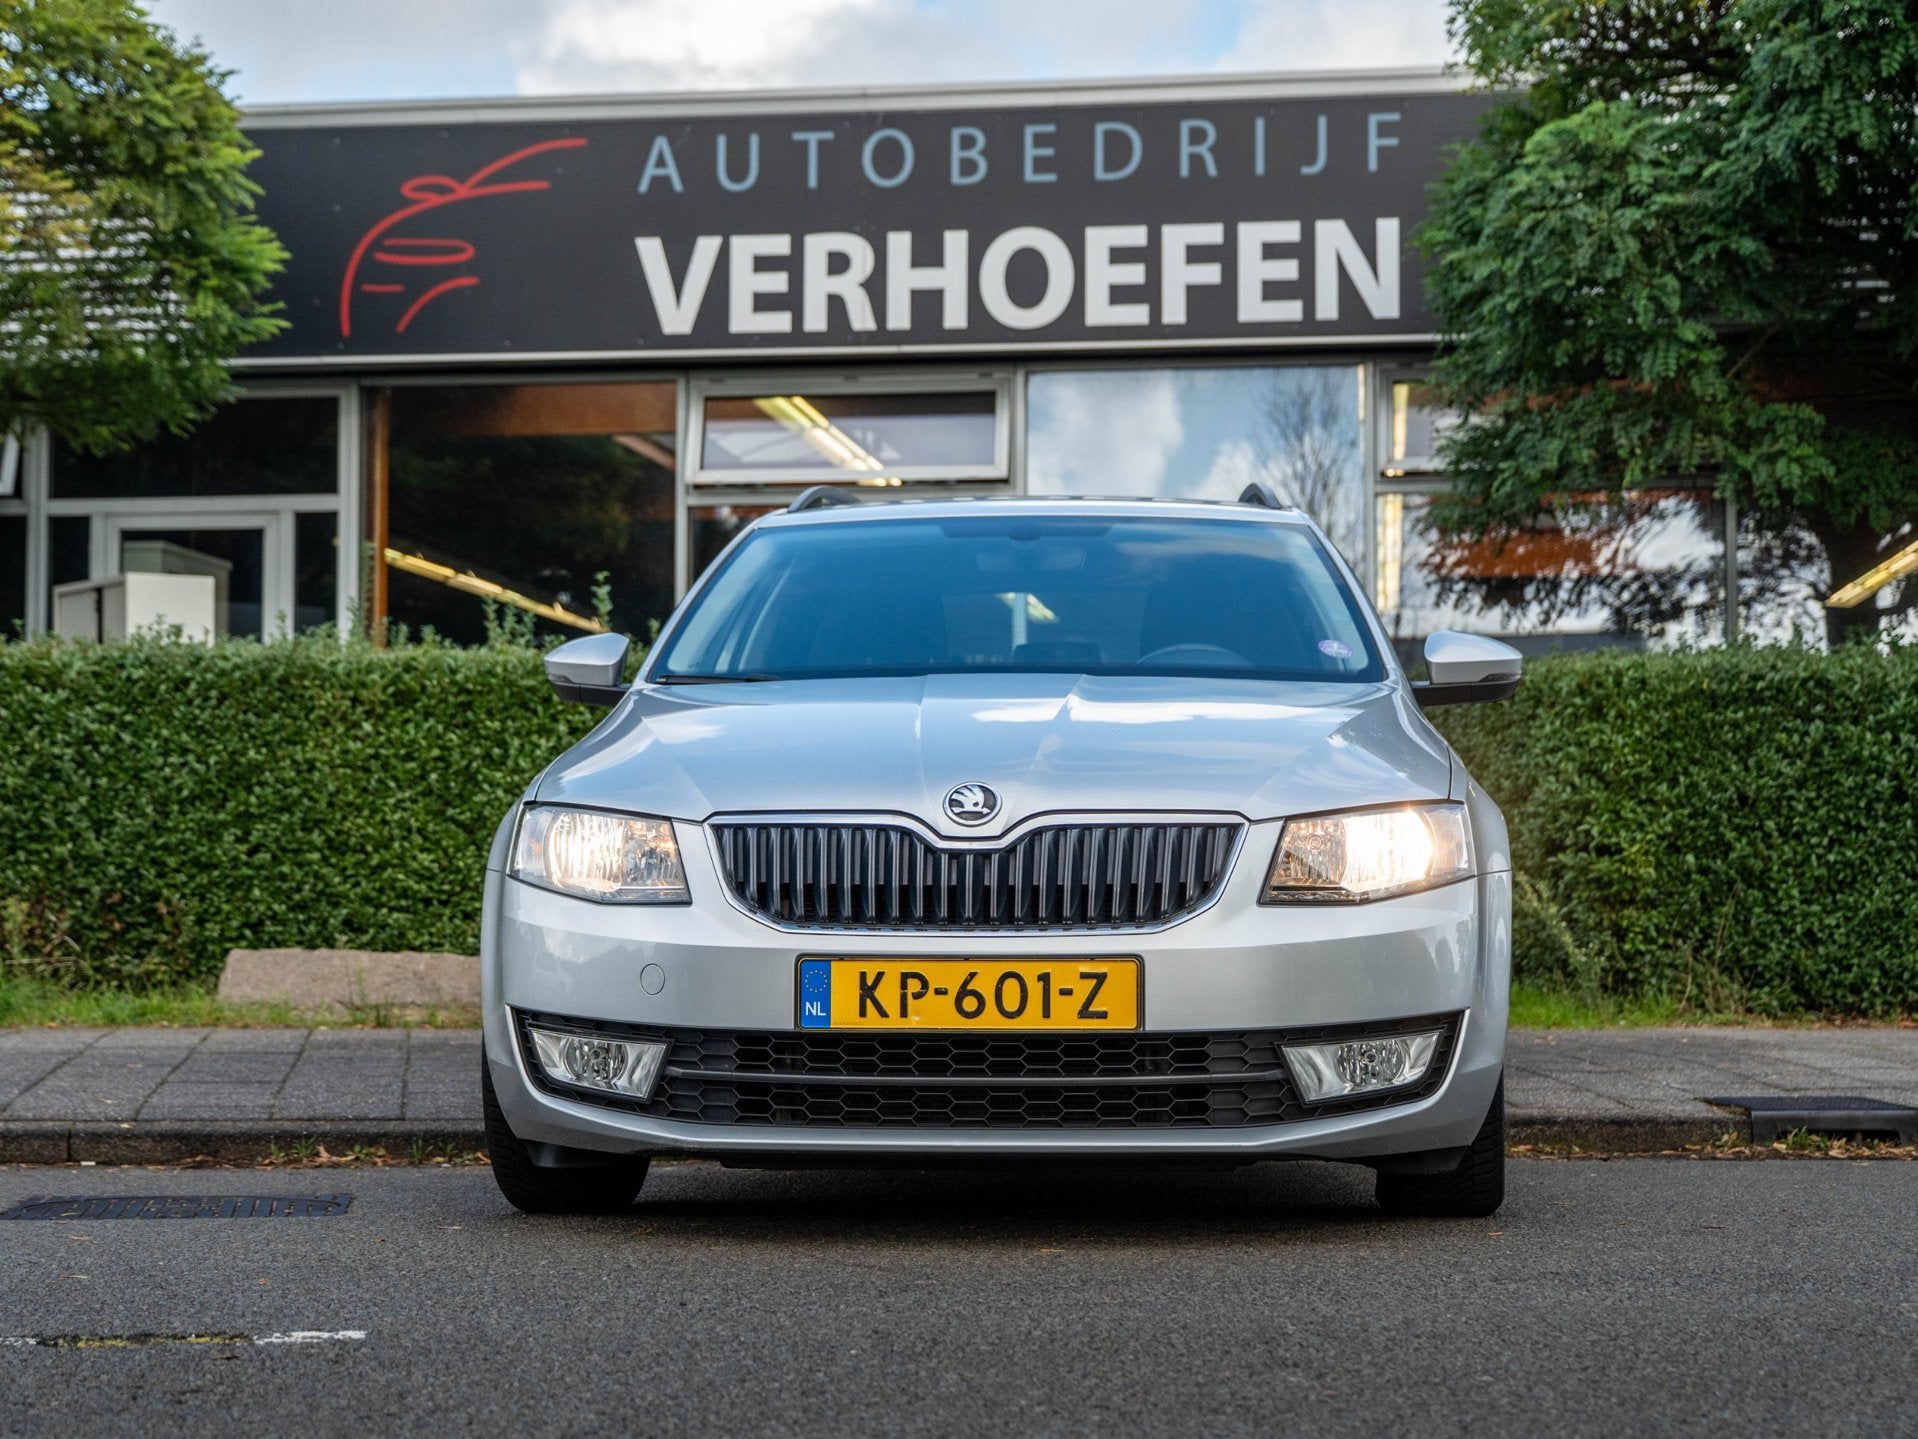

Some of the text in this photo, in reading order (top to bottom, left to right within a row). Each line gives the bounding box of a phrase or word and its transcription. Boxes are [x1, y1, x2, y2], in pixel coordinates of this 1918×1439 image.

[637, 112, 1401, 194] AUTOBEDRIJF
[634, 217, 1401, 336] VERHOEFEN
[805, 1002, 827, 1017] NL
[858, 970, 1109, 1019] KP-601-Z
